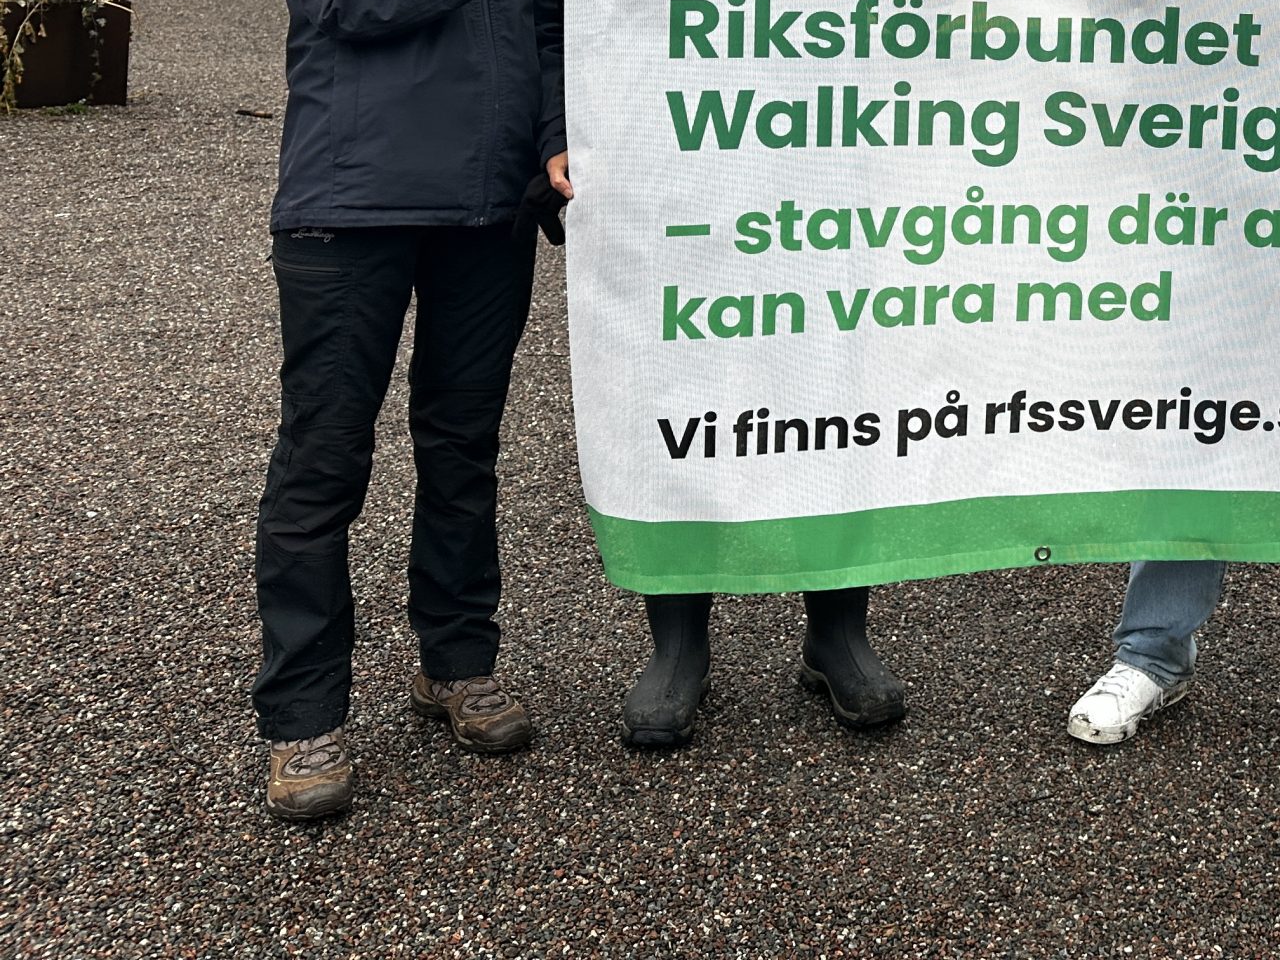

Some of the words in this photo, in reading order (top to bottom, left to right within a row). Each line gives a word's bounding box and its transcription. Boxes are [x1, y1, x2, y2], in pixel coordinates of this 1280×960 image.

[665, 80, 1020, 168] Walking
[734, 185, 1089, 265] stavgång
[1108, 192, 1228, 249] där
[662, 285, 805, 341] kan
[826, 282, 995, 332] vara
[1016, 270, 1173, 322] med
[656, 410, 718, 460] Vi
[732, 406, 881, 457] finns
[896, 389, 969, 458] på
